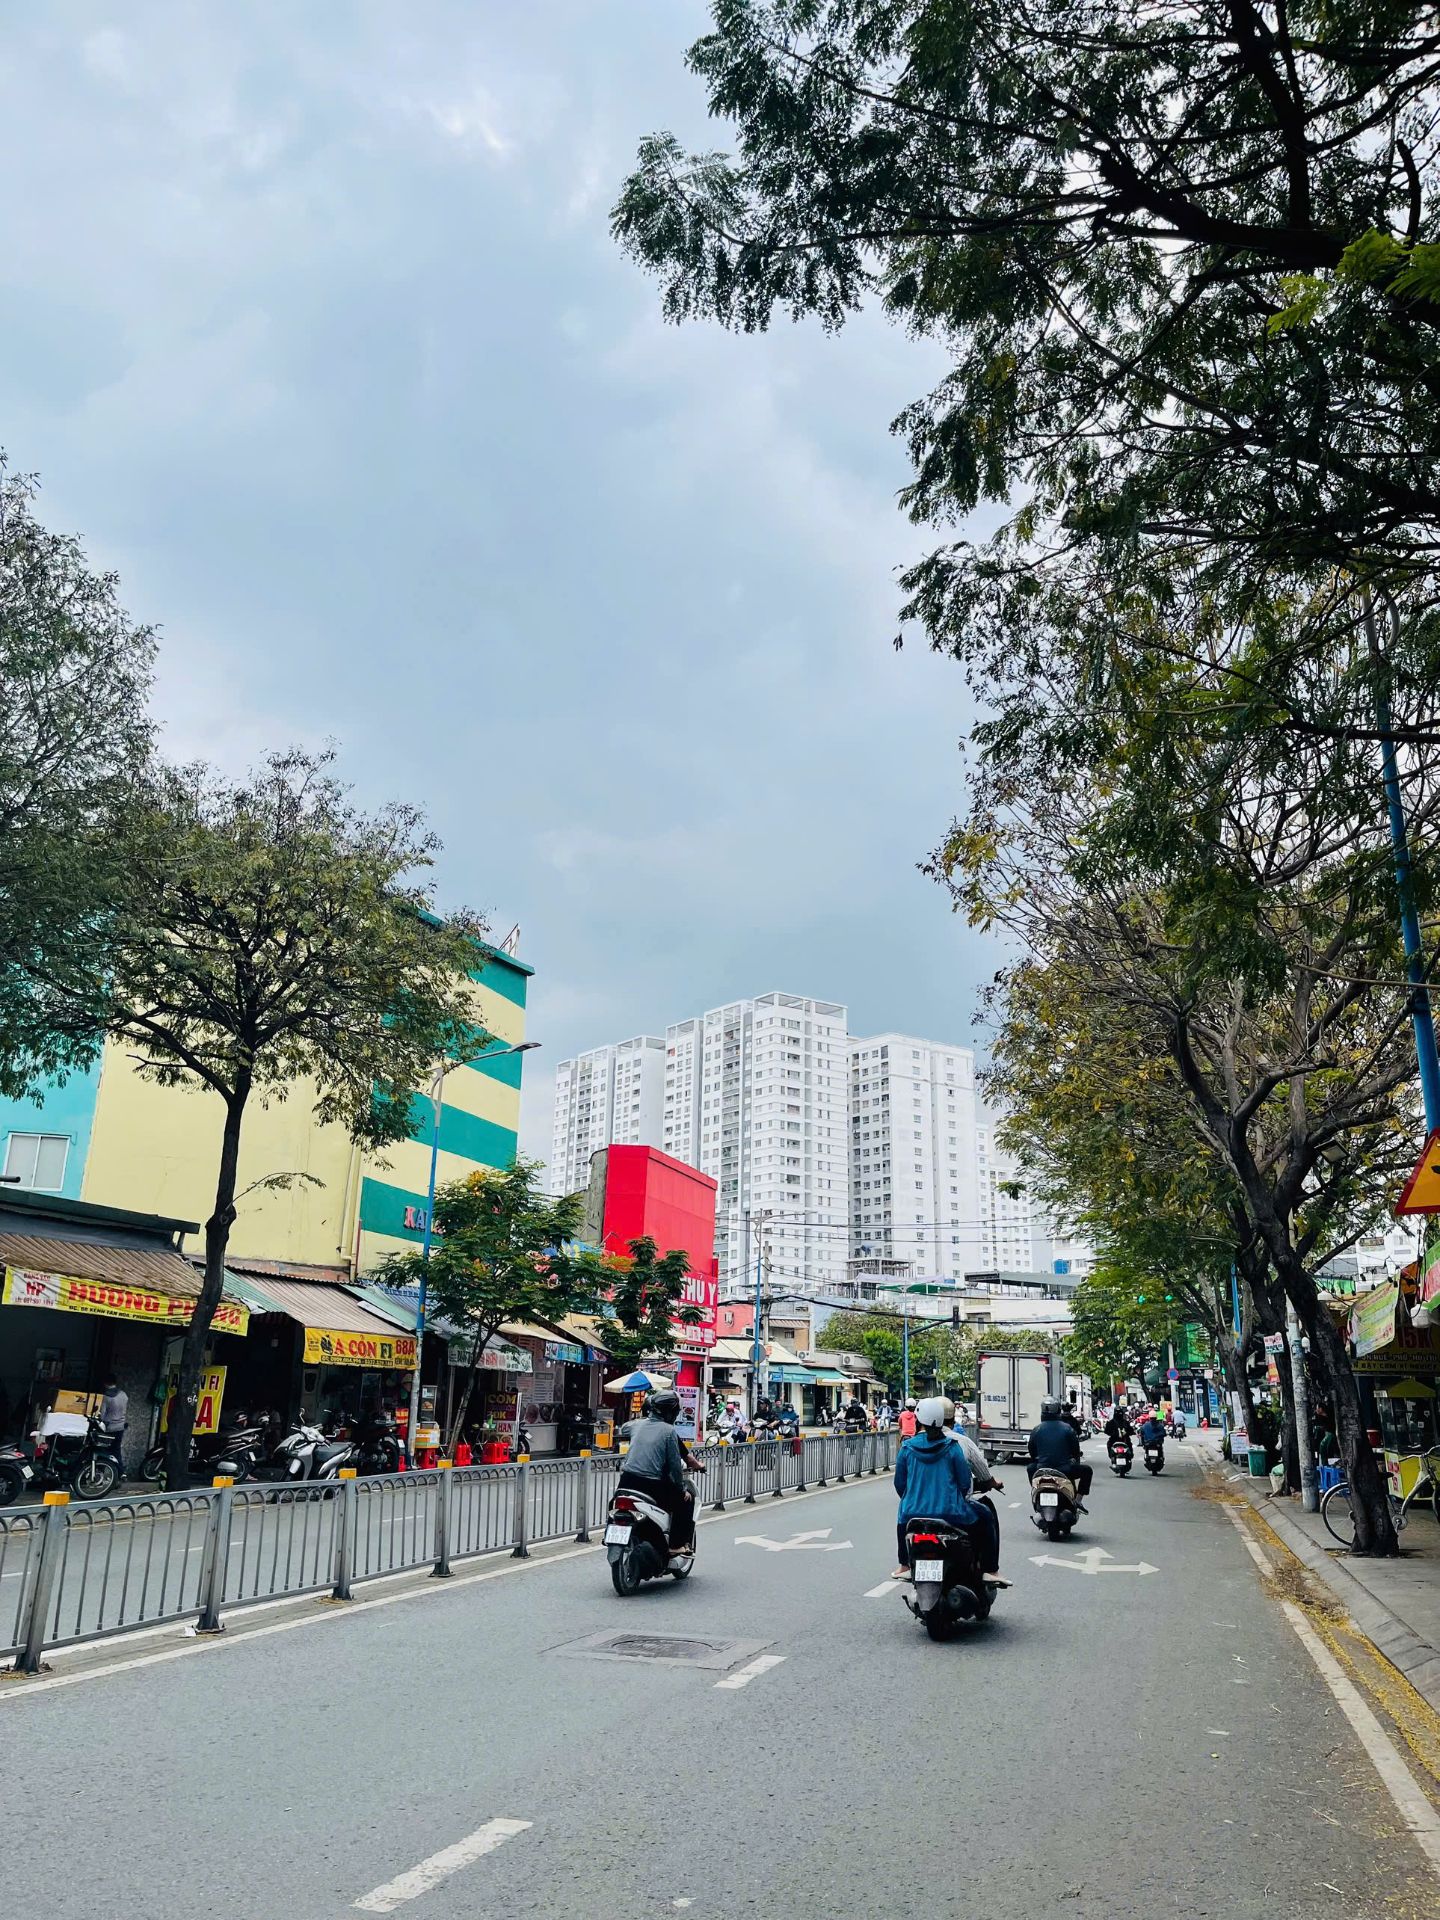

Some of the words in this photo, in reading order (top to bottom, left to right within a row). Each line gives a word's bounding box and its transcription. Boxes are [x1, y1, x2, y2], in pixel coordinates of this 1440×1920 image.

[708, 1283, 717, 1306] Y
[334, 1338, 345, 1356] A
[380, 1342, 394, 1360] FI
[395, 1339, 415, 1356] 68A
[209, 1375, 220, 1390] FI
